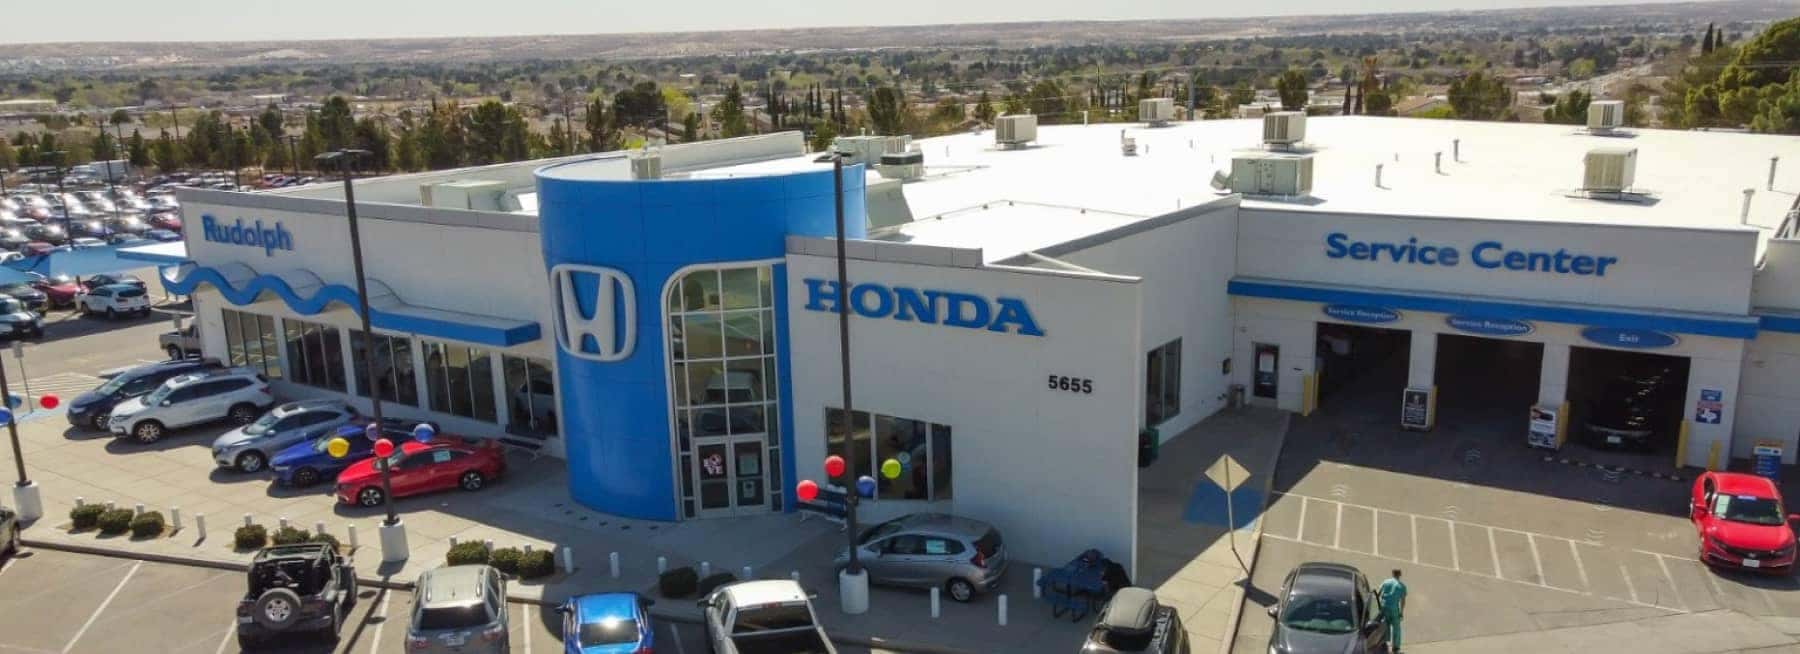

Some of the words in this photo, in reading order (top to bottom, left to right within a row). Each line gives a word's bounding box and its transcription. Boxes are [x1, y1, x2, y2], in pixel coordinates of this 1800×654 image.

[202, 214, 293, 256] Rudolph
[1326, 232, 1459, 266] Service
[1471, 241, 1617, 276] Center
[803, 278, 1046, 336] HONDA
[1328, 307, 1355, 317] Service
[1357, 309, 1396, 320] Reception
[1451, 319, 1482, 329] Service
[1484, 321, 1527, 332] Reception
[1618, 332, 1639, 344] Exit
[1048, 375, 1093, 394] 5655
